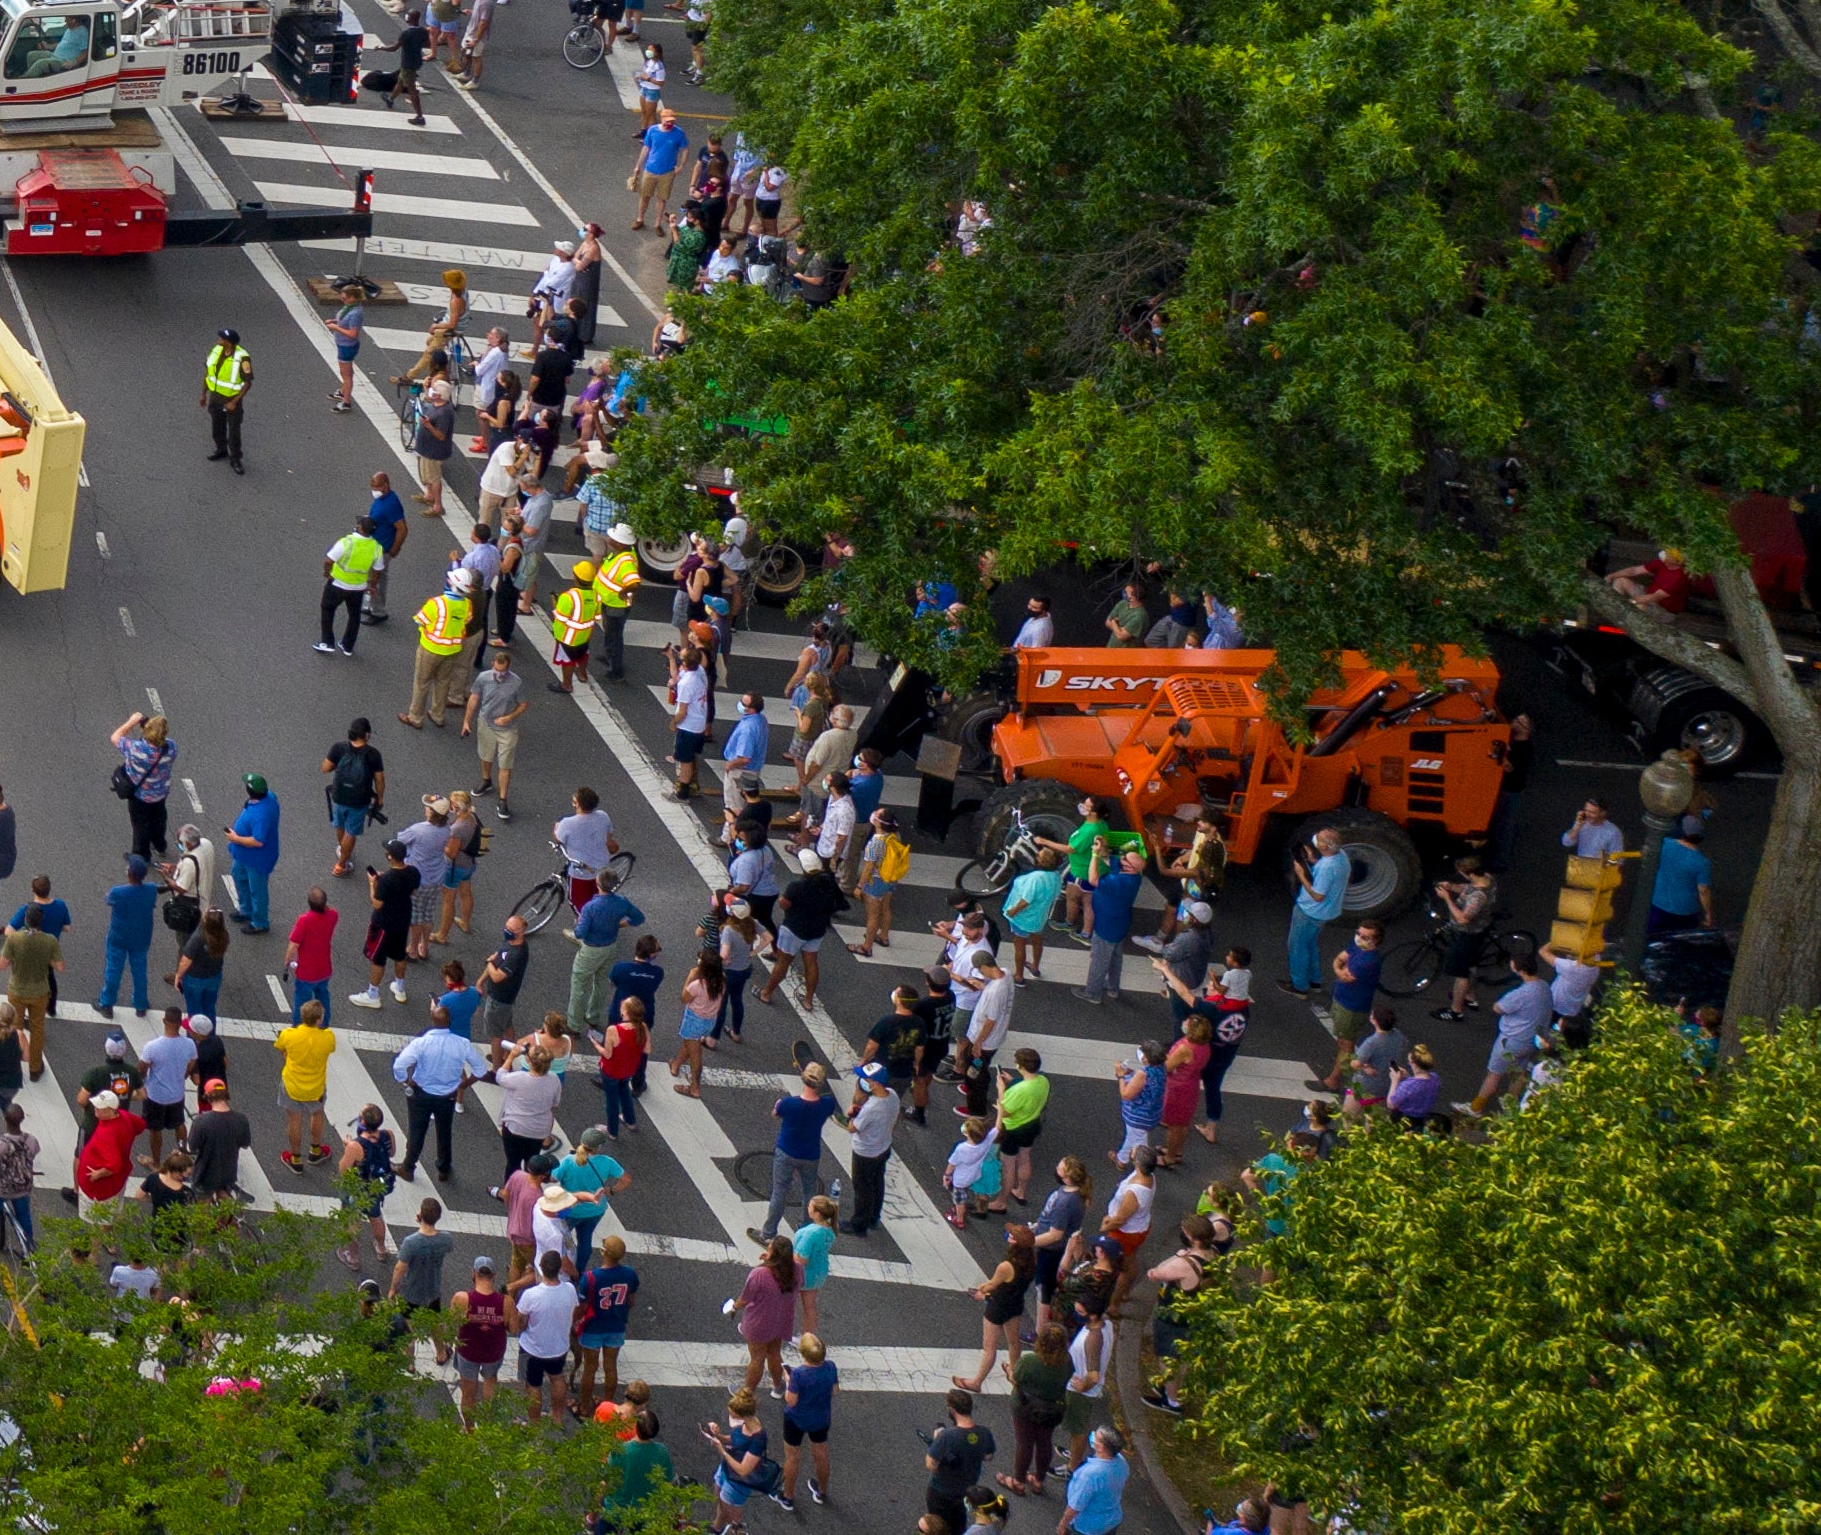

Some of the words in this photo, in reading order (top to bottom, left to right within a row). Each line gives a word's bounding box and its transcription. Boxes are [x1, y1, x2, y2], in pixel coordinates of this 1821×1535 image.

[183, 51, 241, 75] 86100
[1410, 759, 1443, 770] JLG
[599, 1283, 628, 1310] 27
